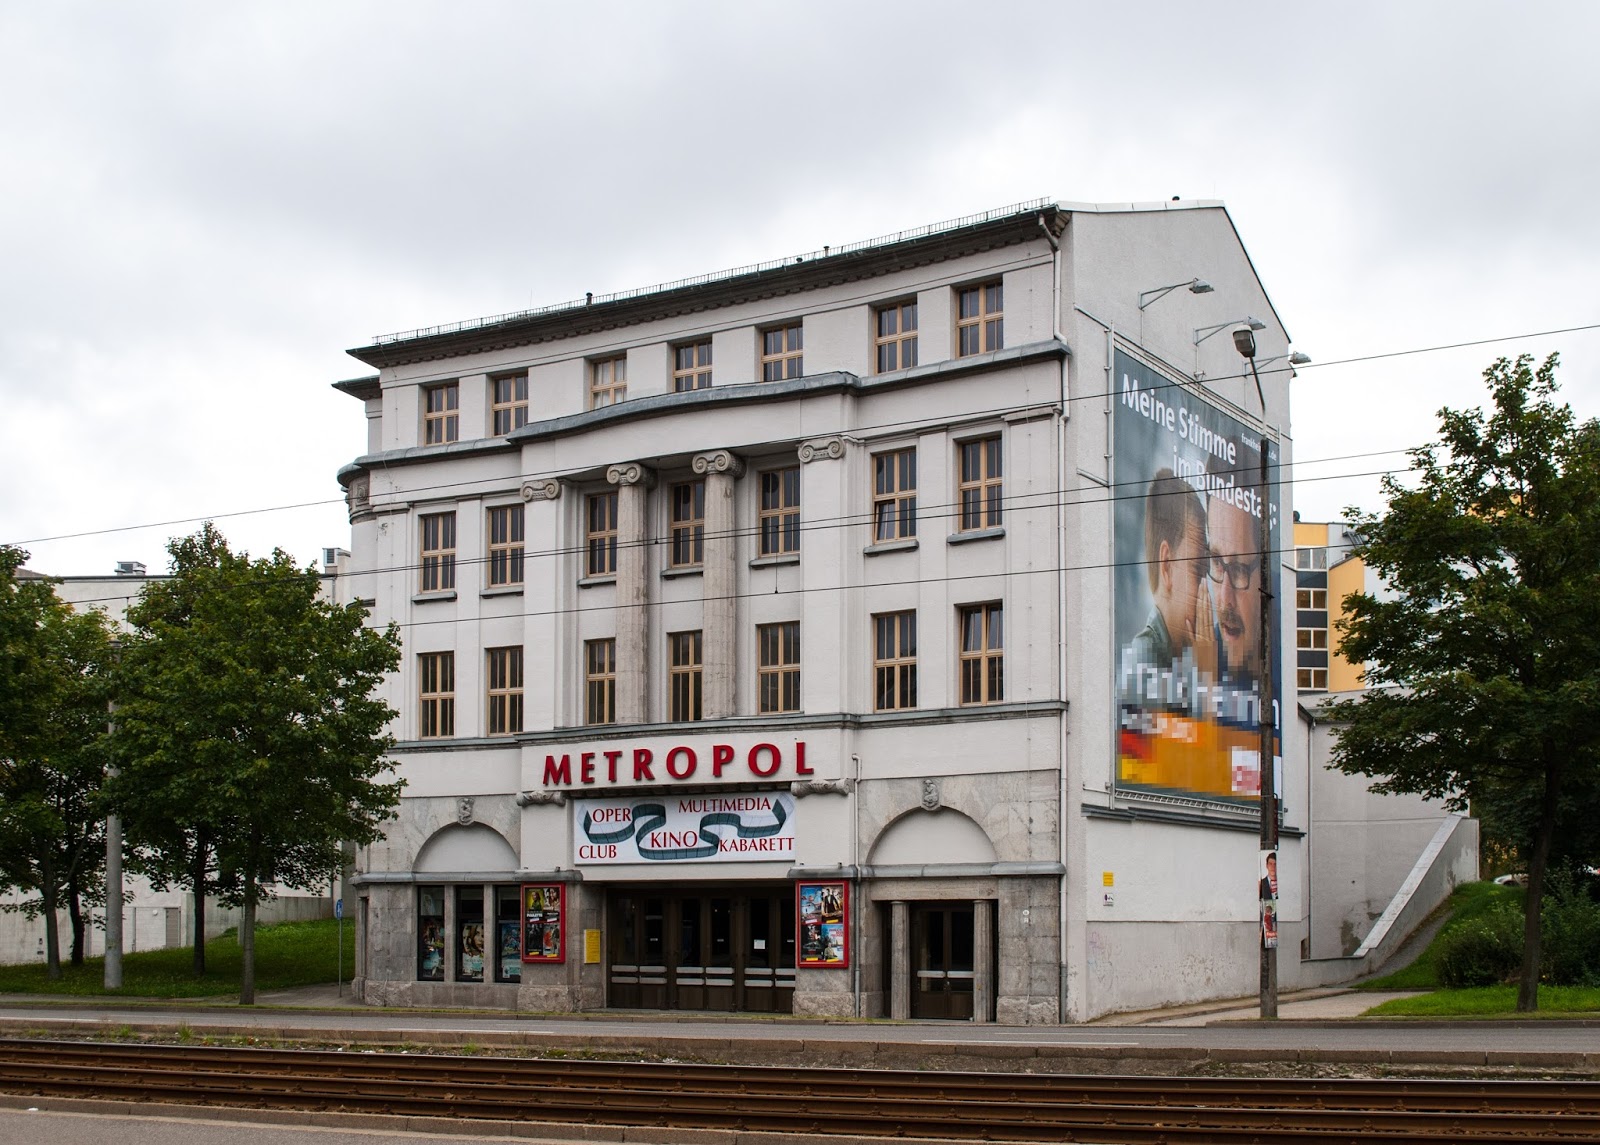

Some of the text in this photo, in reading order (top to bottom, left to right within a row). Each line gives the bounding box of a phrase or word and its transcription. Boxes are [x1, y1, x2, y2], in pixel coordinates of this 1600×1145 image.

[1122, 374, 1236, 465] Meine Stimme
[1173, 446, 1192, 482] im
[543, 742, 814, 785] METROPOL
[678, 797, 771, 814] MULTIMEDIA
[592, 807, 631, 823] OPER
[650, 831, 698, 848] KINO
[719, 837, 795, 852] KABARETT
[579, 845, 617, 859] CLUB
